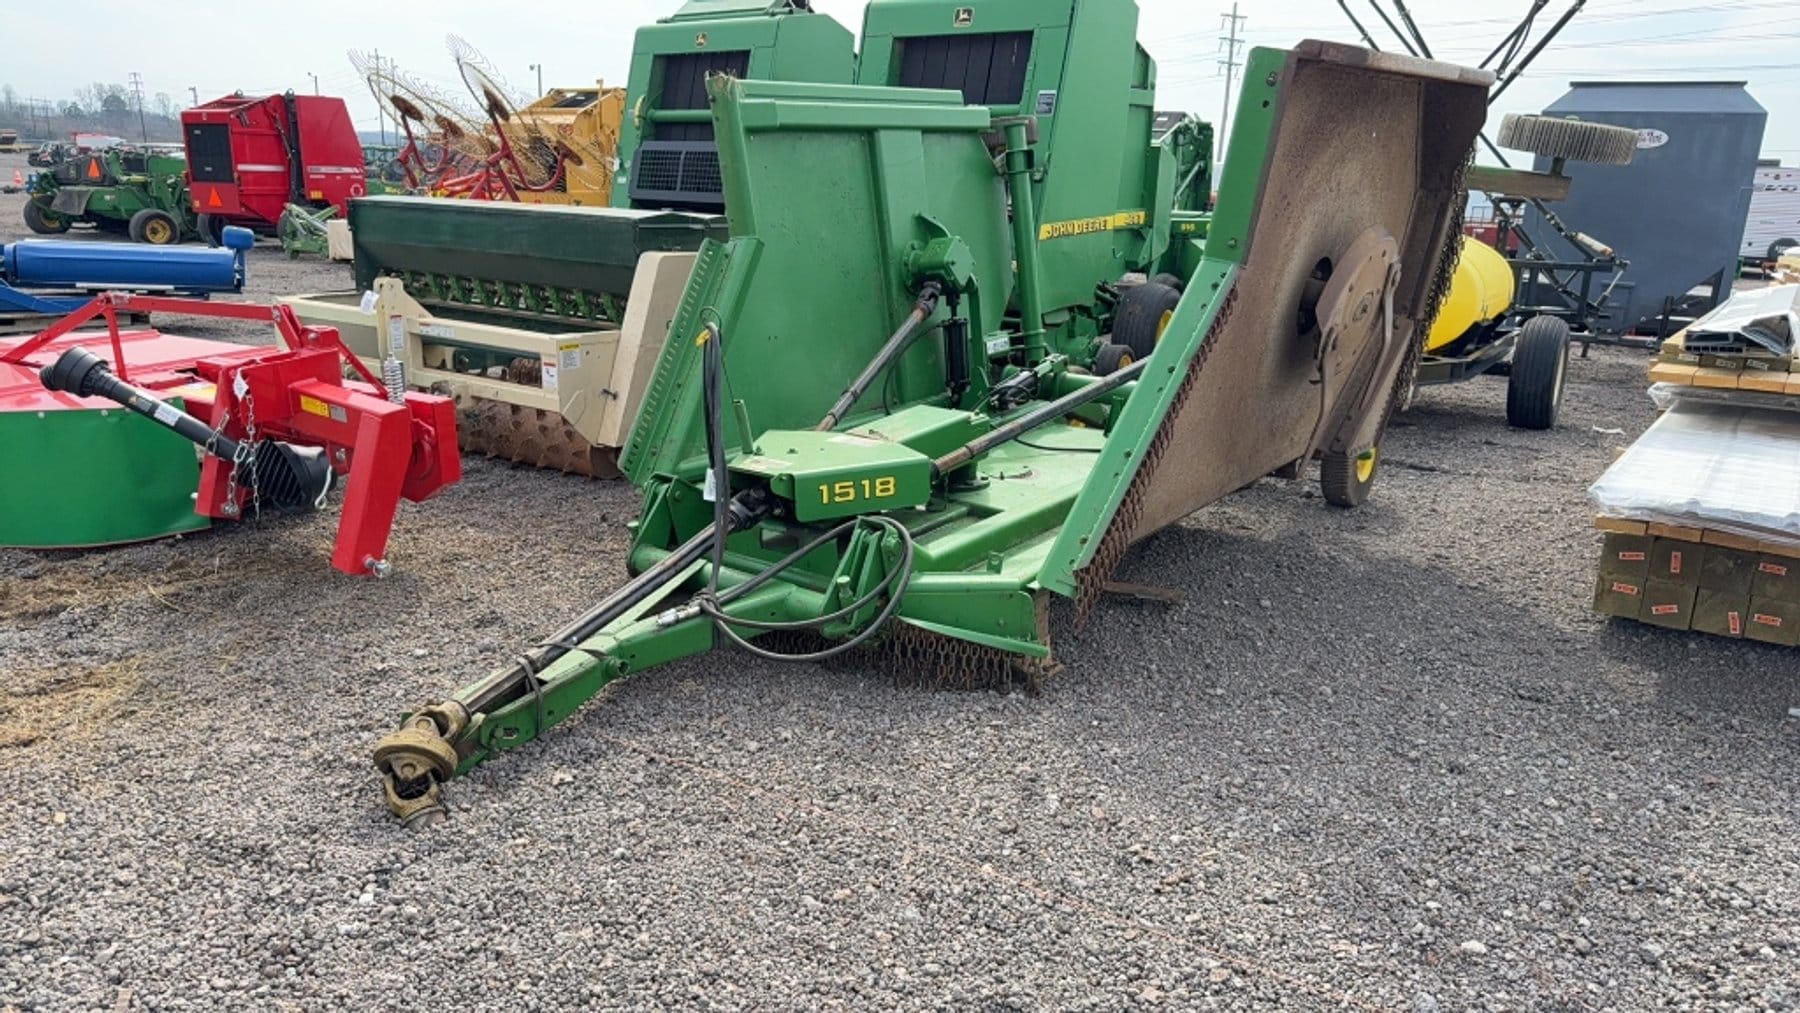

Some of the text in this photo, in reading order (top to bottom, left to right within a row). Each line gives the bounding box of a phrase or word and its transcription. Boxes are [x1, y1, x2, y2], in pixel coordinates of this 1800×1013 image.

[1046, 222, 1075, 239] JOHN
[1076, 218, 1107, 235] DEERE
[818, 476, 896, 504] 1518
